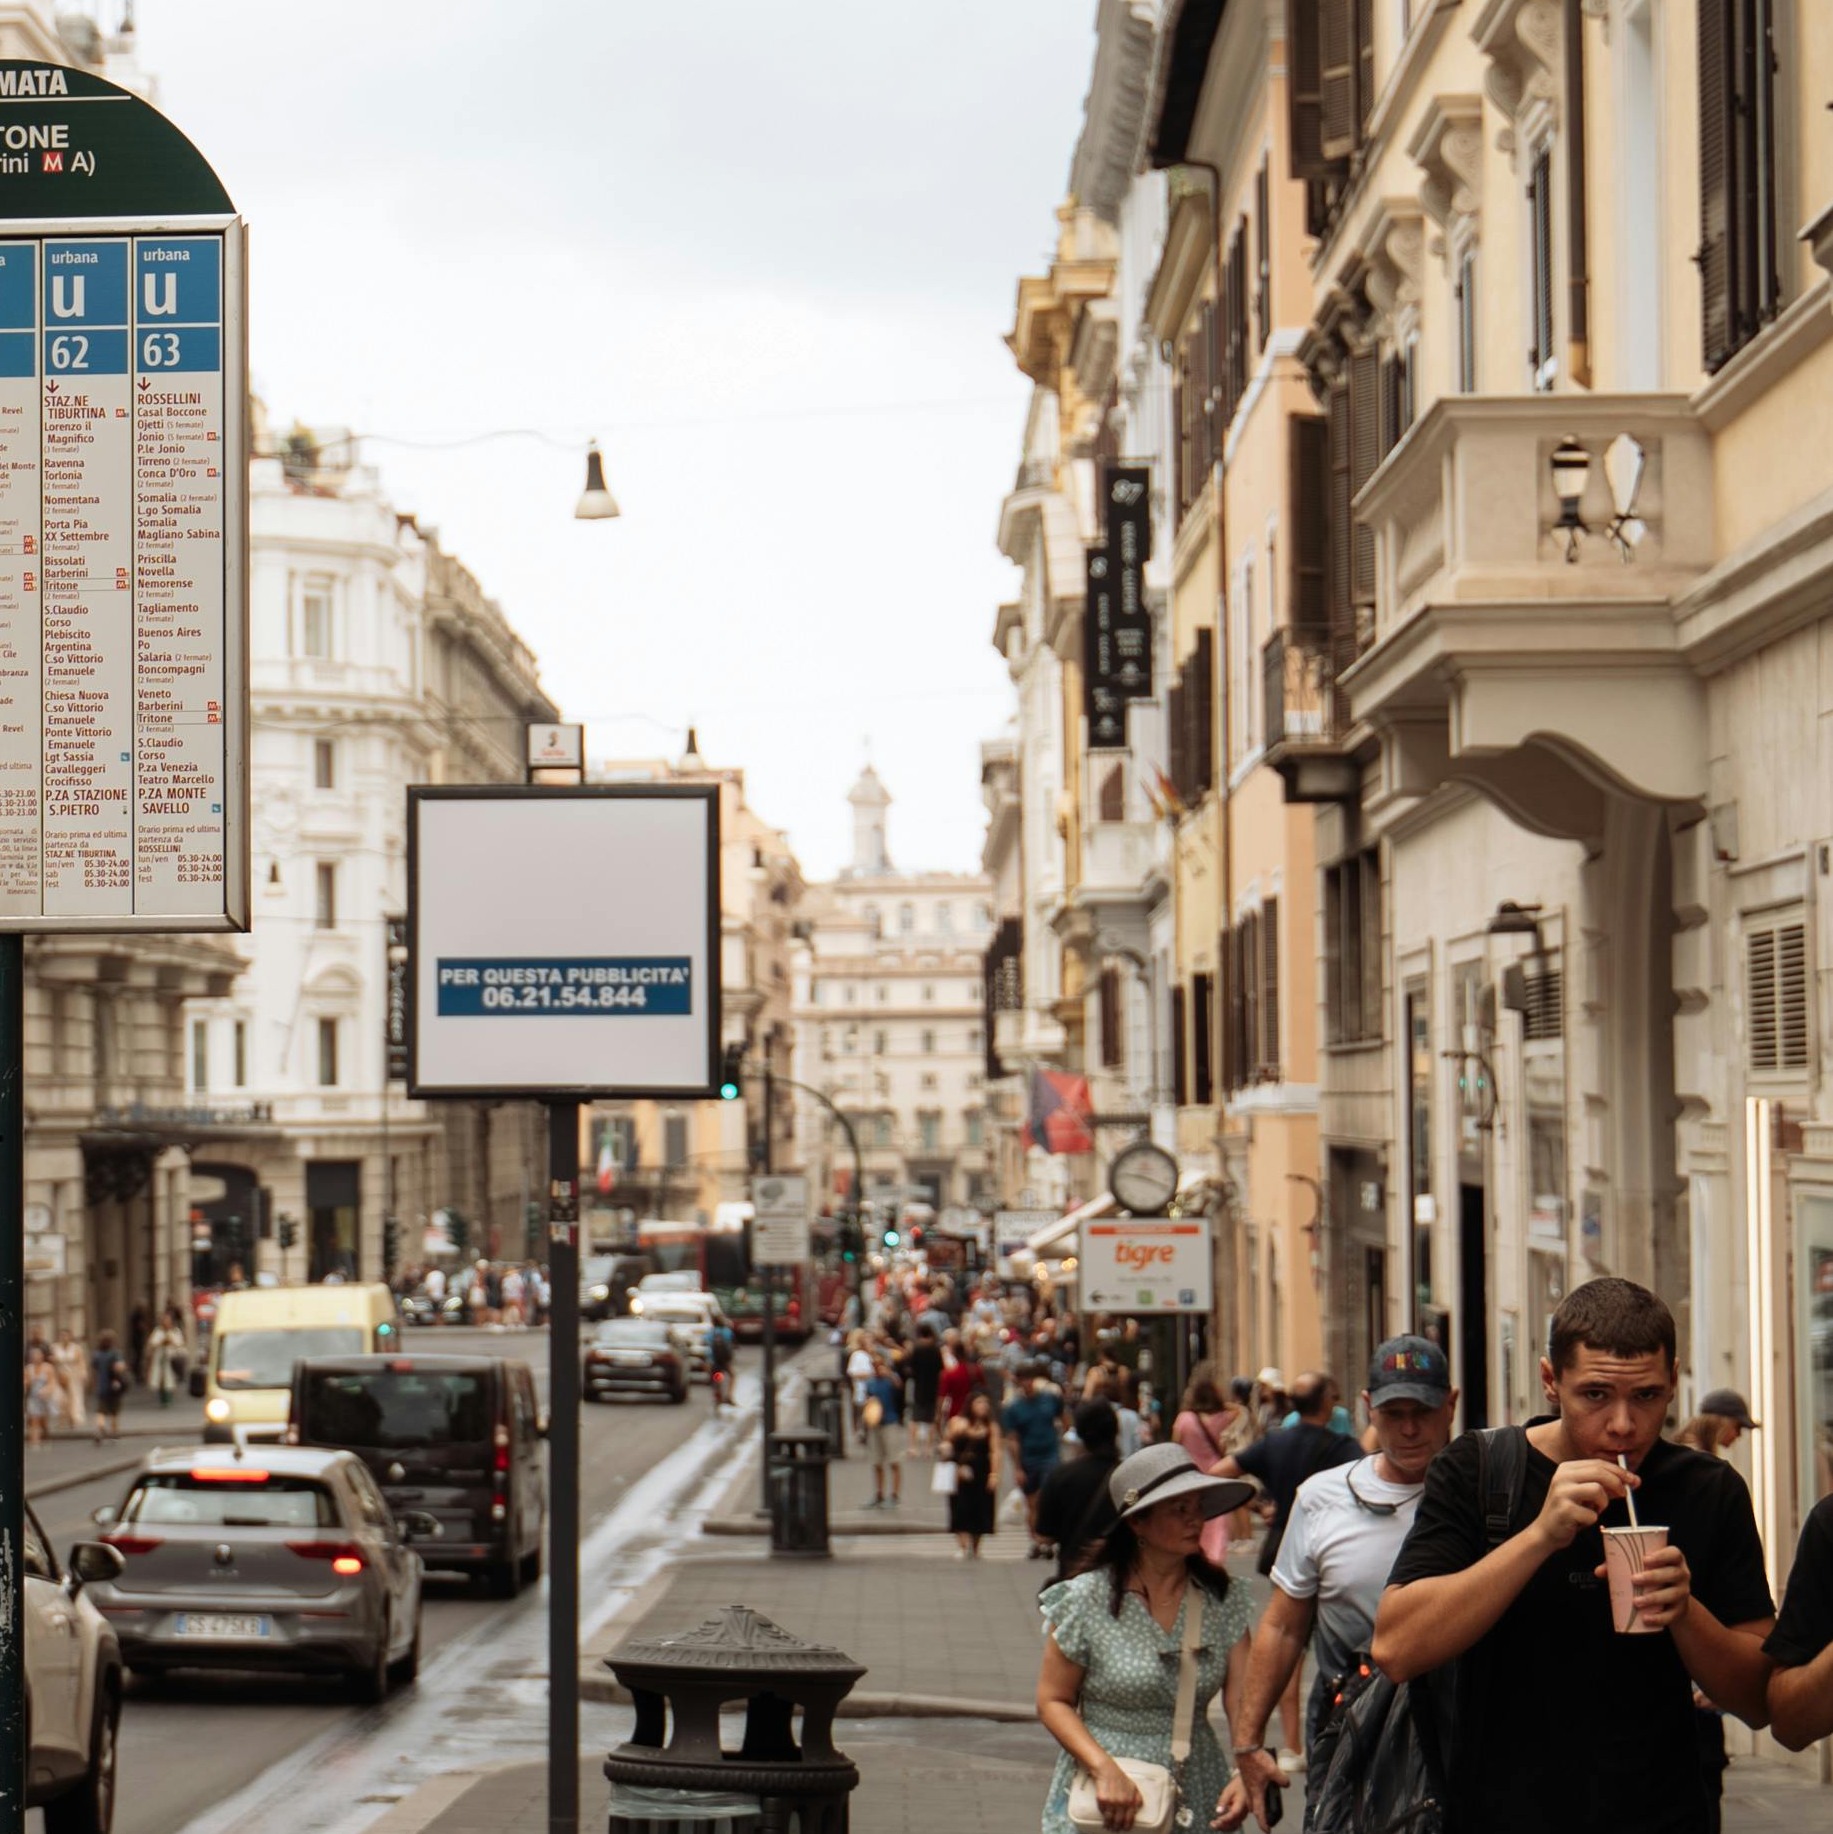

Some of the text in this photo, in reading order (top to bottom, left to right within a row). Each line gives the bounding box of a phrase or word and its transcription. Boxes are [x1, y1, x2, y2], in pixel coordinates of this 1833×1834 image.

[51, 250, 99, 264] urbana
[143, 247, 191, 262] urbana
[52, 275, 85, 318] u
[144, 272, 177, 316] u
[51, 335, 89, 369] 62
[143, 333, 181, 367] 63
[44, 395, 89, 408] STAZ.NE
[137, 392, 201, 405] ROSSELLINI
[47, 407, 106, 420] TIBURTINA
[137, 406, 207, 418] Casal Boccone
[137, 456, 171, 466] Tirreno
[44, 495, 100, 505] Nomentana
[137, 528, 220, 542] Magliano Sabina
[137, 553, 177, 564] Priscilla
[44, 629, 91, 640] Plebiscito
[44, 763, 106, 776] Cavalleggeri
[45, 788, 128, 801] P.ZA STAZIONE
[49, 803, 100, 816] S.PIETRO
[142, 802, 190, 815] SAVELLO
[177, 854, 223, 863] 05.30-24.00
[440, 967, 689, 985] PER QUESTA PUBBLICITA'
[482, 985, 647, 1008] 06.21.54.844
[1114, 1239, 1176, 1271] tigre
